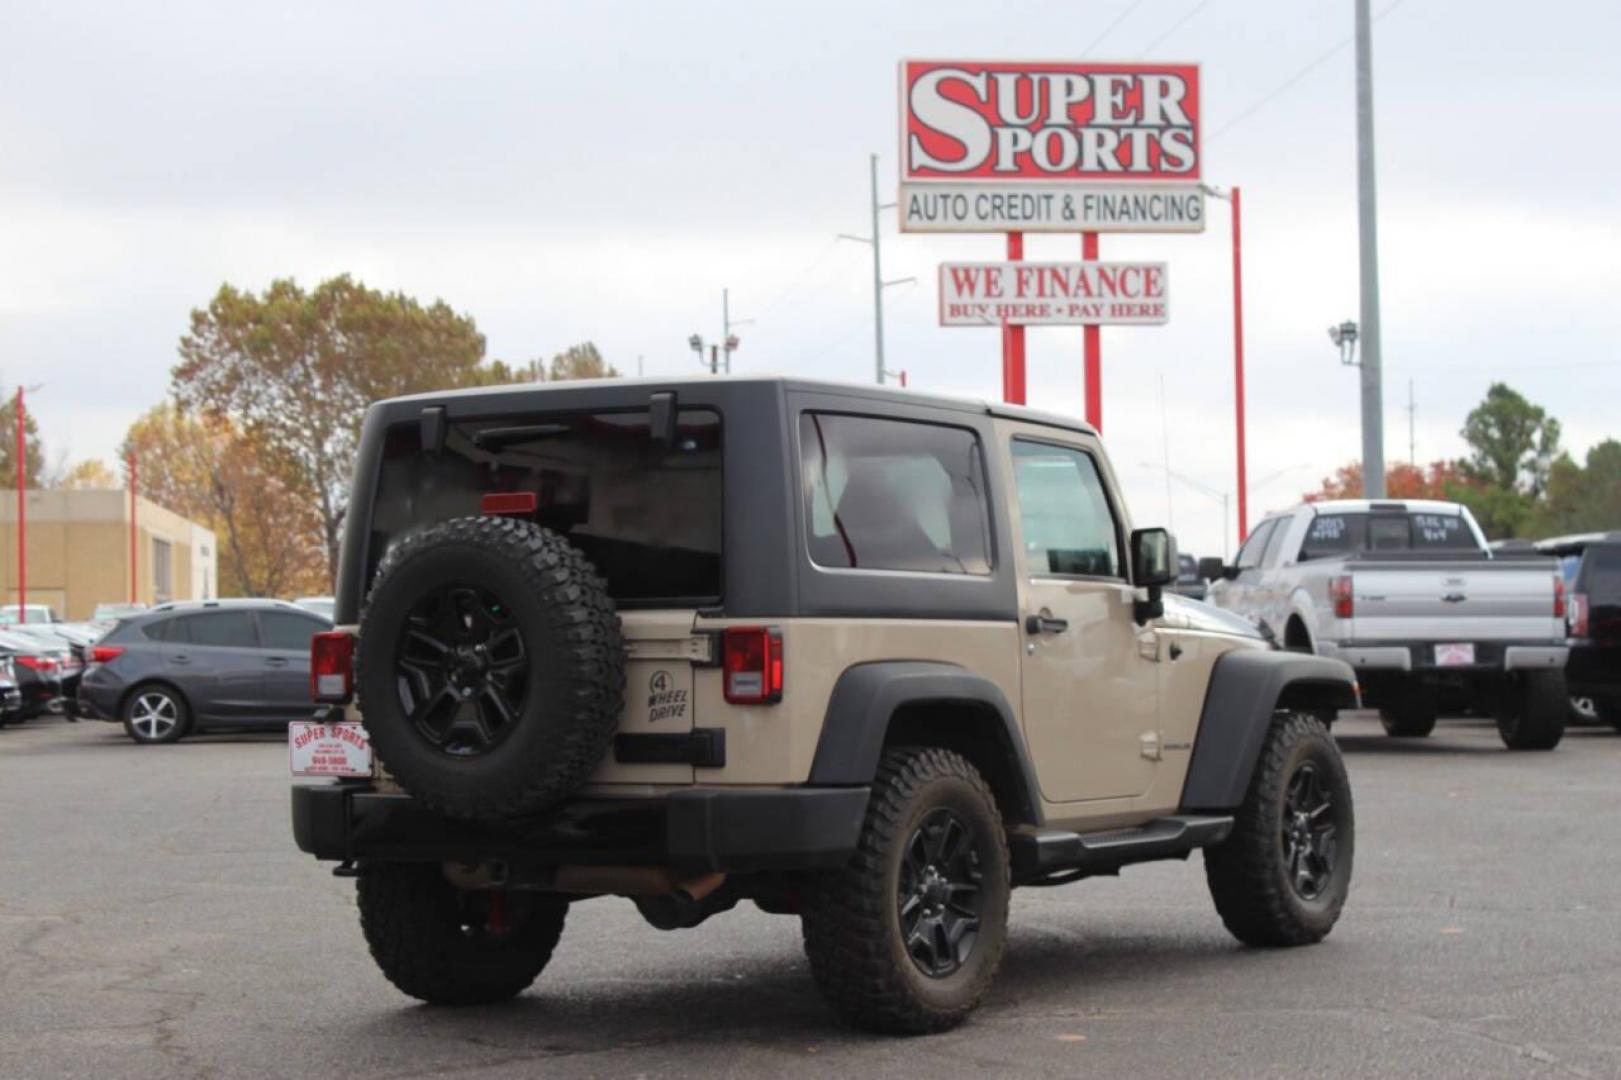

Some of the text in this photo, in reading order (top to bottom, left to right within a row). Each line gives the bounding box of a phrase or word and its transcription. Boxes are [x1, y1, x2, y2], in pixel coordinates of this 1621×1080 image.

[907, 194, 1201, 221] AUTO CREDIT & FINANCING
[950, 266, 1164, 299] WE FINANCE
[949, 303, 1165, 318] BUY HERE PAY HERE
[654, 673, 667, 691] 4
[647, 689, 688, 708] WHEEL
[648, 703, 687, 723] DRIVE
[294, 726, 325, 750] SUPER
